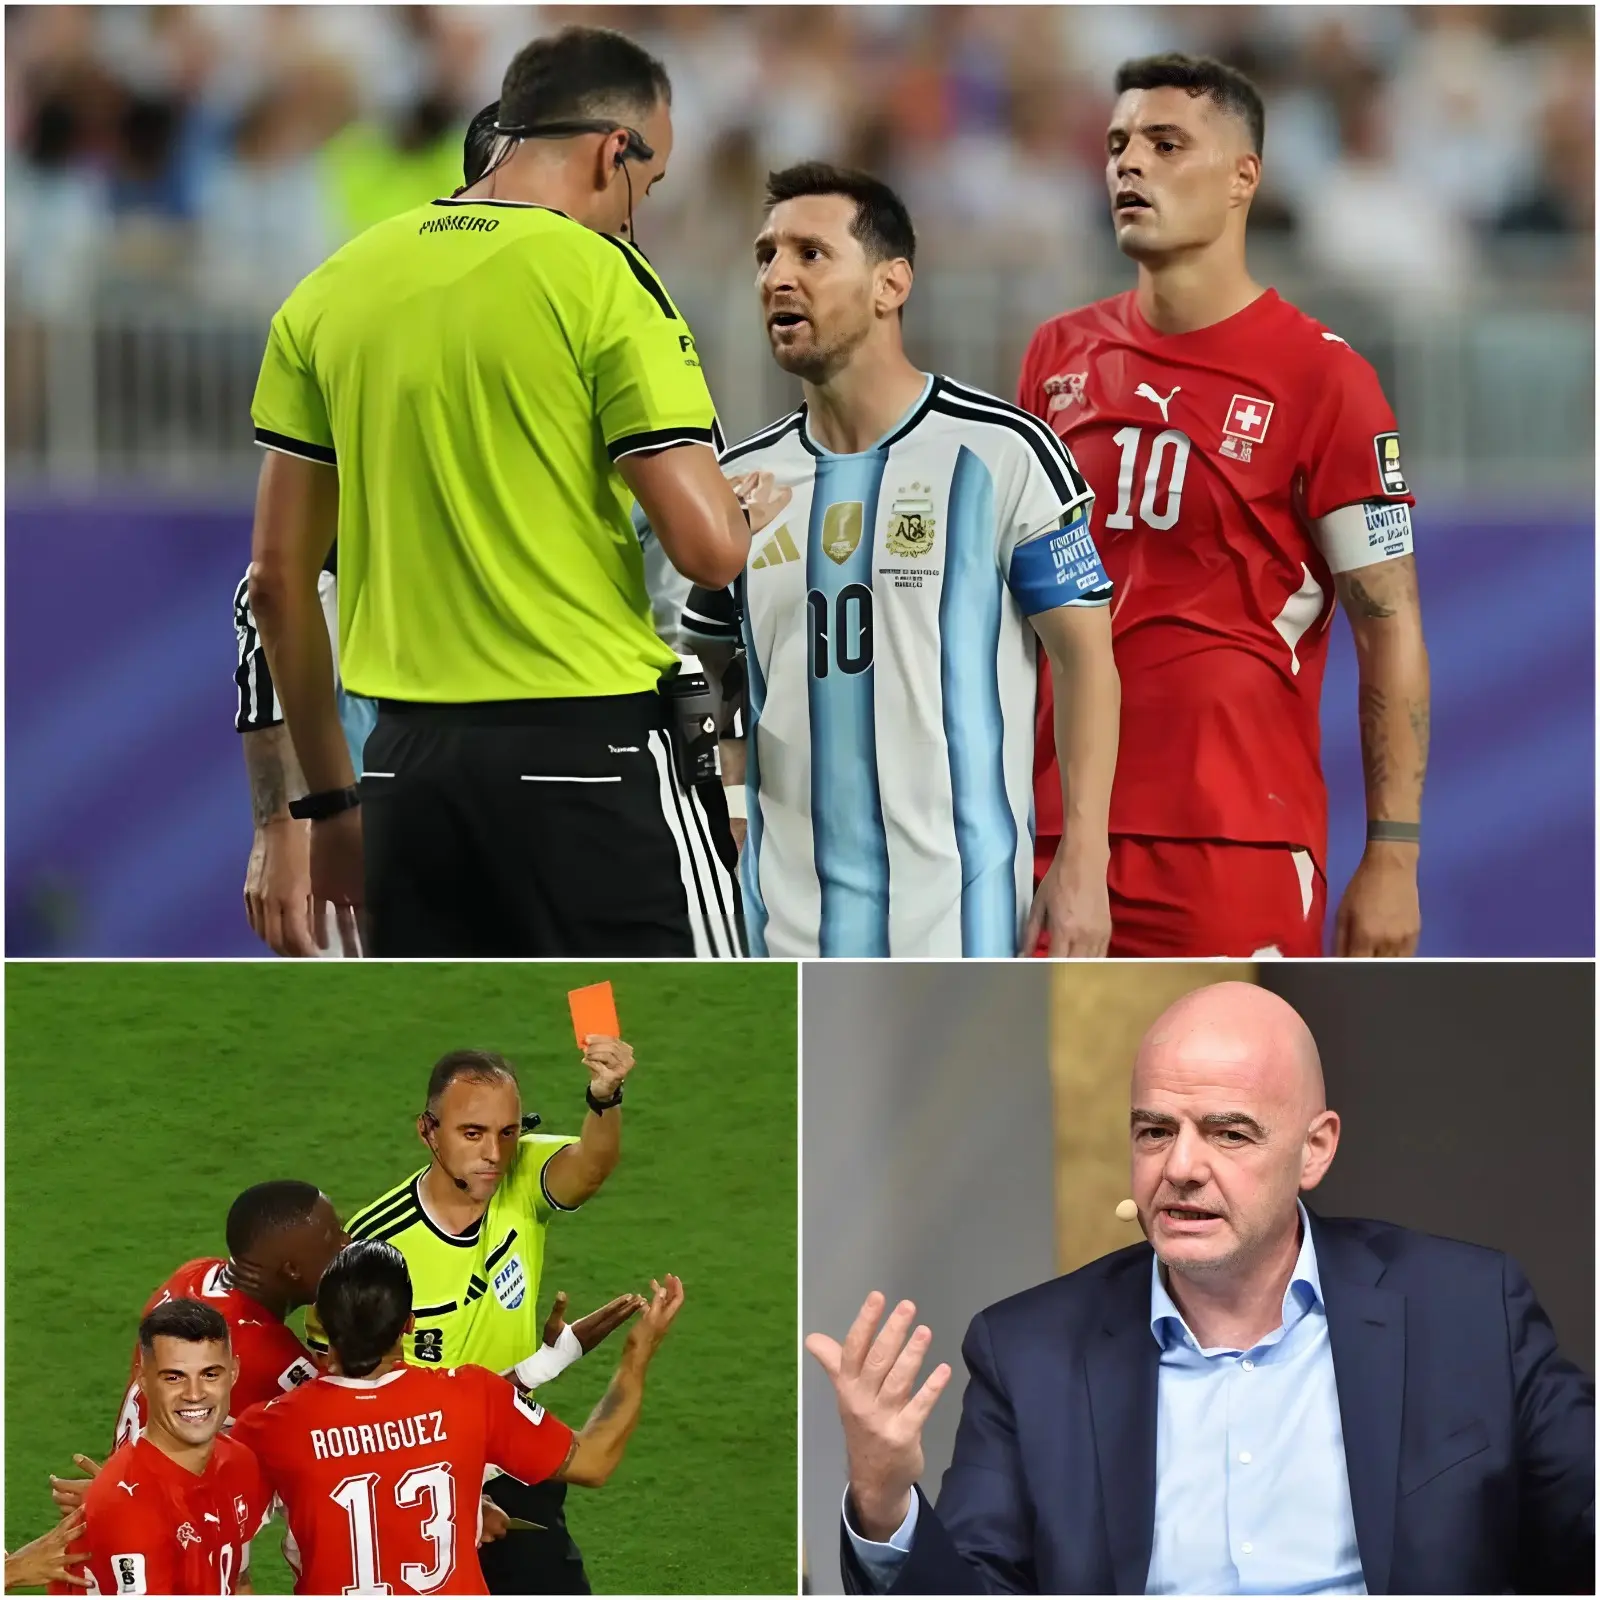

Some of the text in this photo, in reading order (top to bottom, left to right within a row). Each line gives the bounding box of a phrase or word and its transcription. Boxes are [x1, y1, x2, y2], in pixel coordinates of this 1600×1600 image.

[1104, 426, 1192, 531] 10
[805, 583, 875, 680] 10
[494, 1259, 519, 1290] FIFA
[310, 1410, 448, 1461] RODRIGUEZ
[328, 1460, 457, 1596] 13
